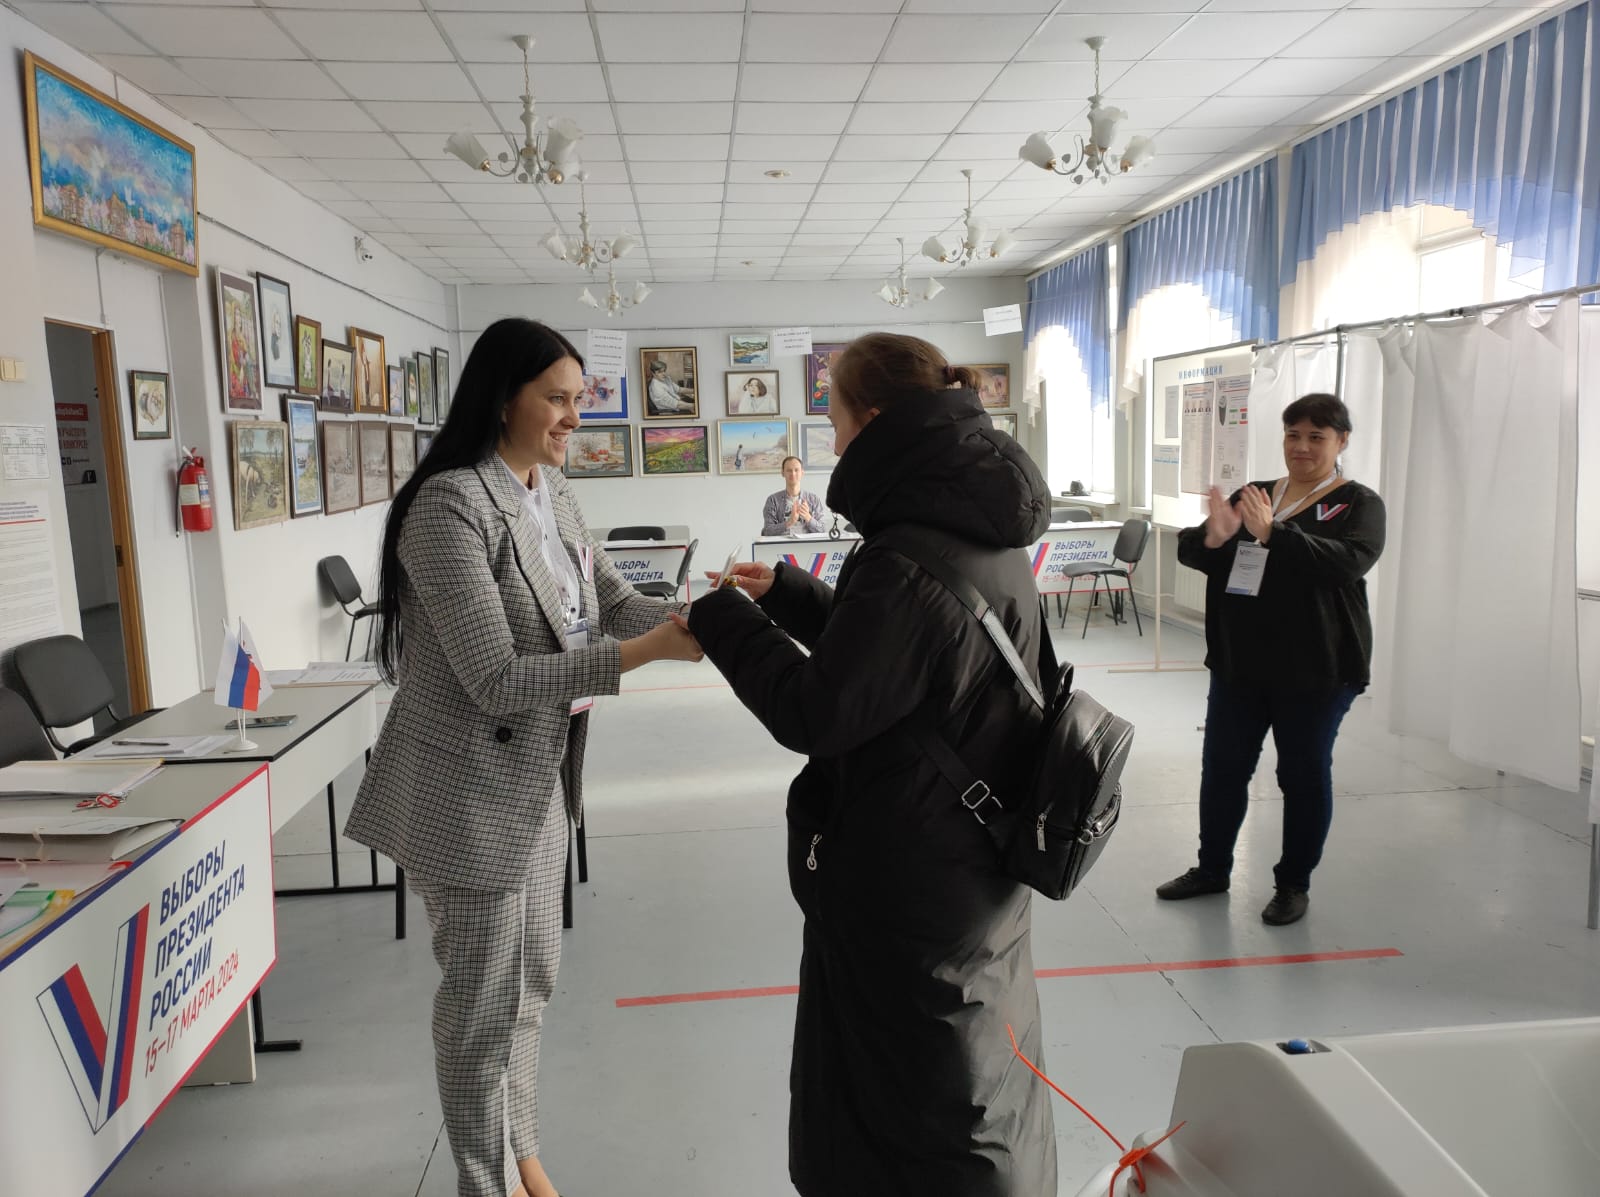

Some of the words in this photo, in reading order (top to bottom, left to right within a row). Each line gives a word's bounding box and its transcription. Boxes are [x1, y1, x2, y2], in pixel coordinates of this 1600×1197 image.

[614, 560, 650, 570] ЫБОРЫ
[1050, 551, 1108, 561] ПРЕЗИДЕНТА
[1054, 540, 1096, 550] ВЫБОРЫ
[622, 571, 664, 582] ЗИДЕНТА
[160, 840, 226, 926] ВЫБОРЫ
[154, 863, 246, 978] ПРЕЗИДЕНТА
[148, 936, 213, 1032] РОССИИ
[179, 975, 216, 1039] МАРТА
[216, 948, 240, 996] 2024
